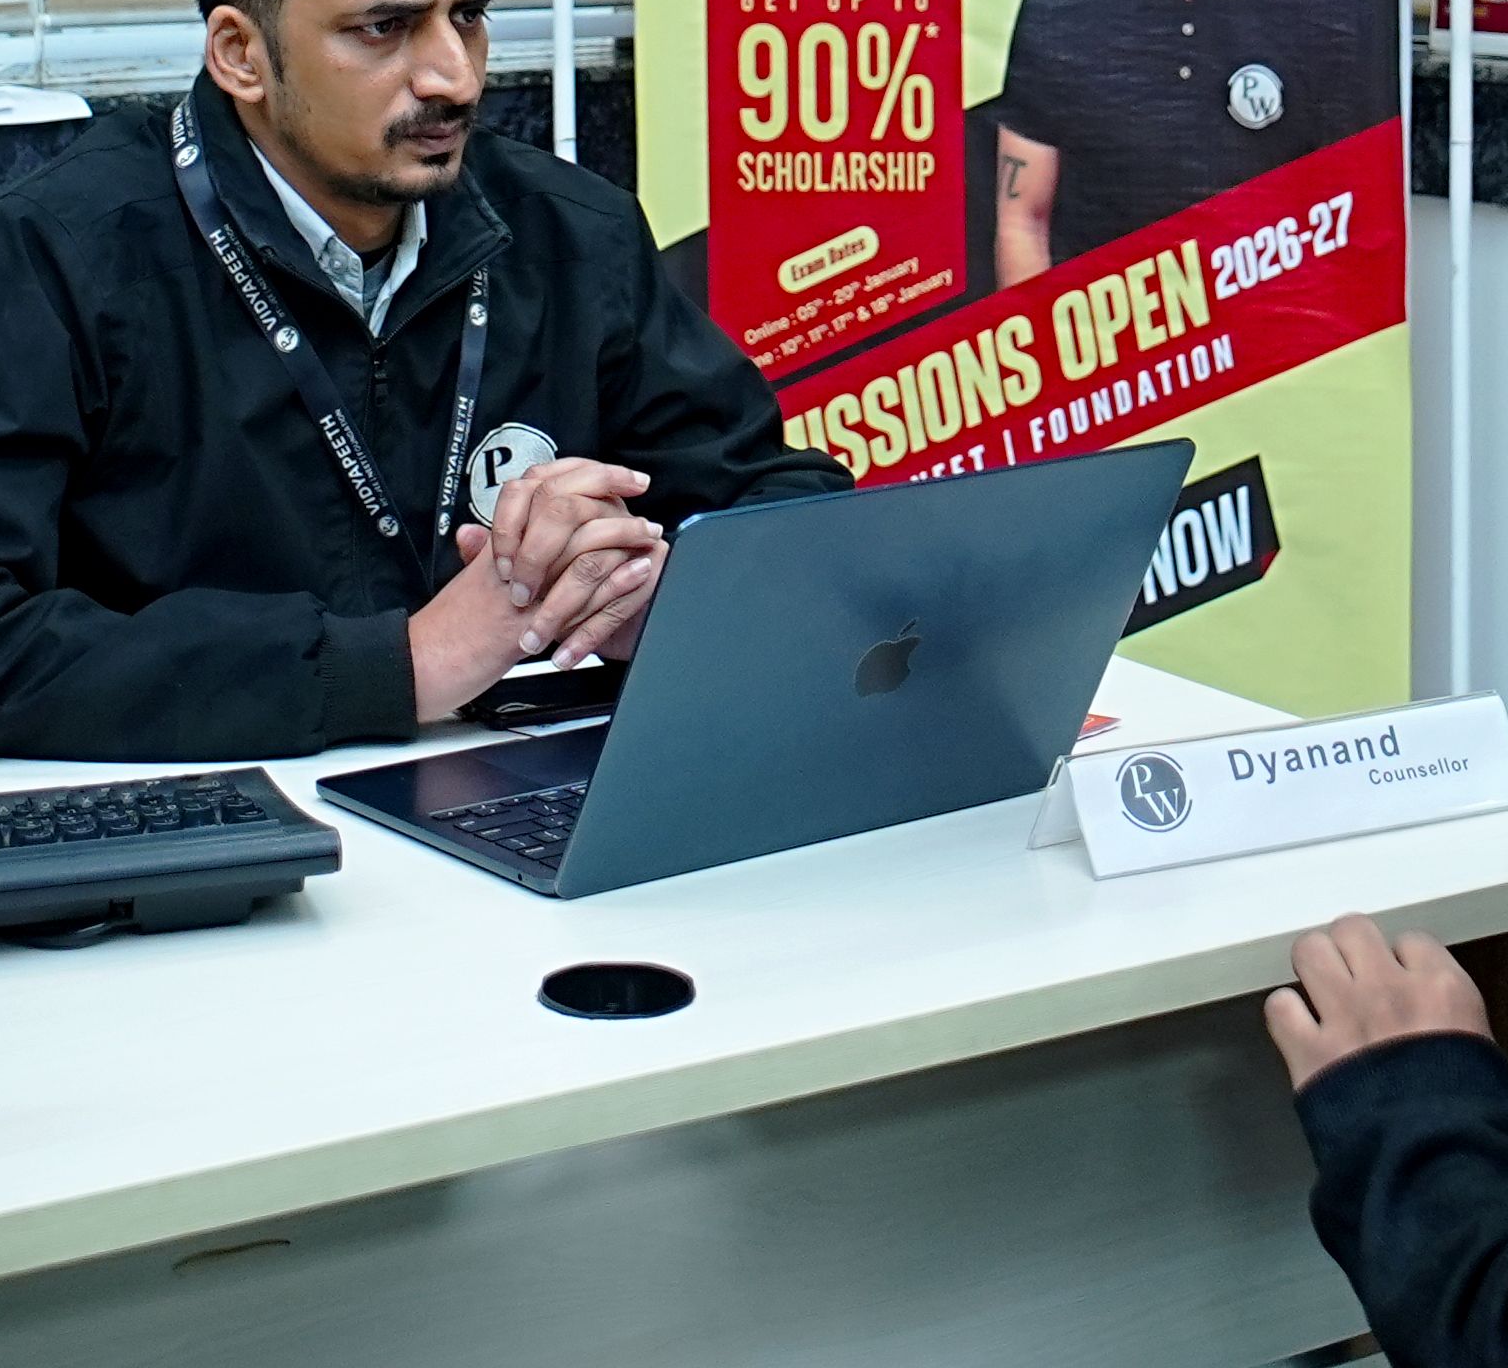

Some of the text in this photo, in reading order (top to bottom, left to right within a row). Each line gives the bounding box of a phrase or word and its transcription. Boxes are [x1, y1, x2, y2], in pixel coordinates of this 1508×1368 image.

[737, 150, 936, 193] SCHOLARSHIP
[209, 229, 277, 332] VIDYAPEETH
[1052, 238, 1211, 382] OPEN
[1210, 191, 1354, 301] 2026-27
[1028, 333, 1236, 454] FOUNDATION
[319, 414, 381, 517] VIDYAPEETH
[441, 395, 470, 507] VIDYAPEETH
[1143, 485, 1253, 605] NOW
[1227, 725, 1401, 785] Dyanand
[1368, 754, 1470, 787] Counsellor
